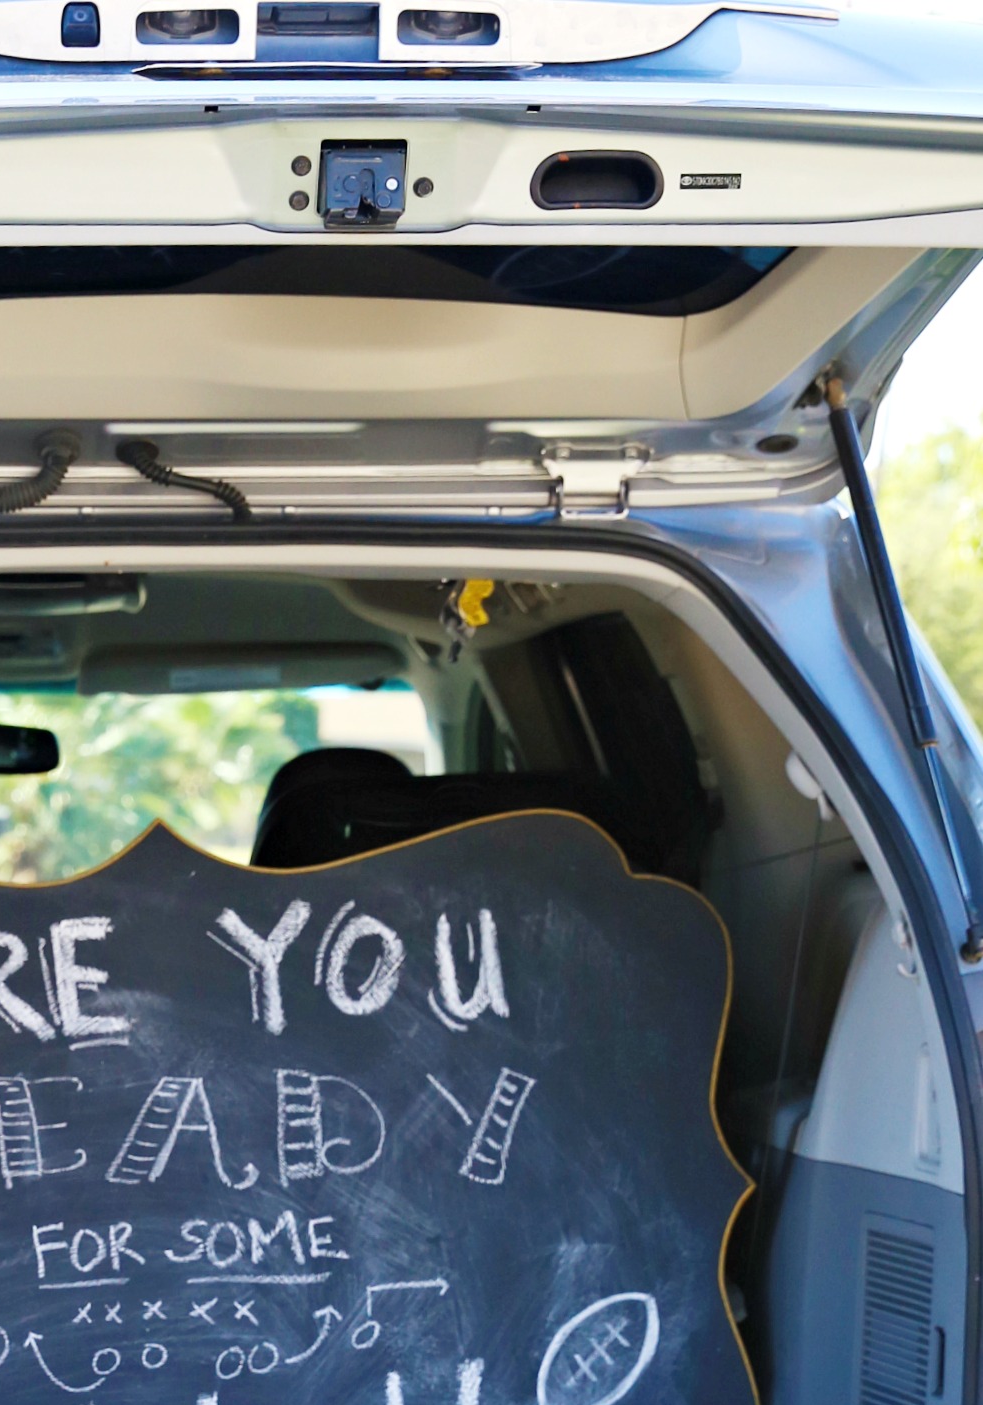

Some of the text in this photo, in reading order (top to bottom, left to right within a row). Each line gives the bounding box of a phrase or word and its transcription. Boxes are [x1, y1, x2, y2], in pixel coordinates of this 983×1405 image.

[208, 900, 510, 1034] YOU
[32, 1211, 349, 1277] FOR SOME
